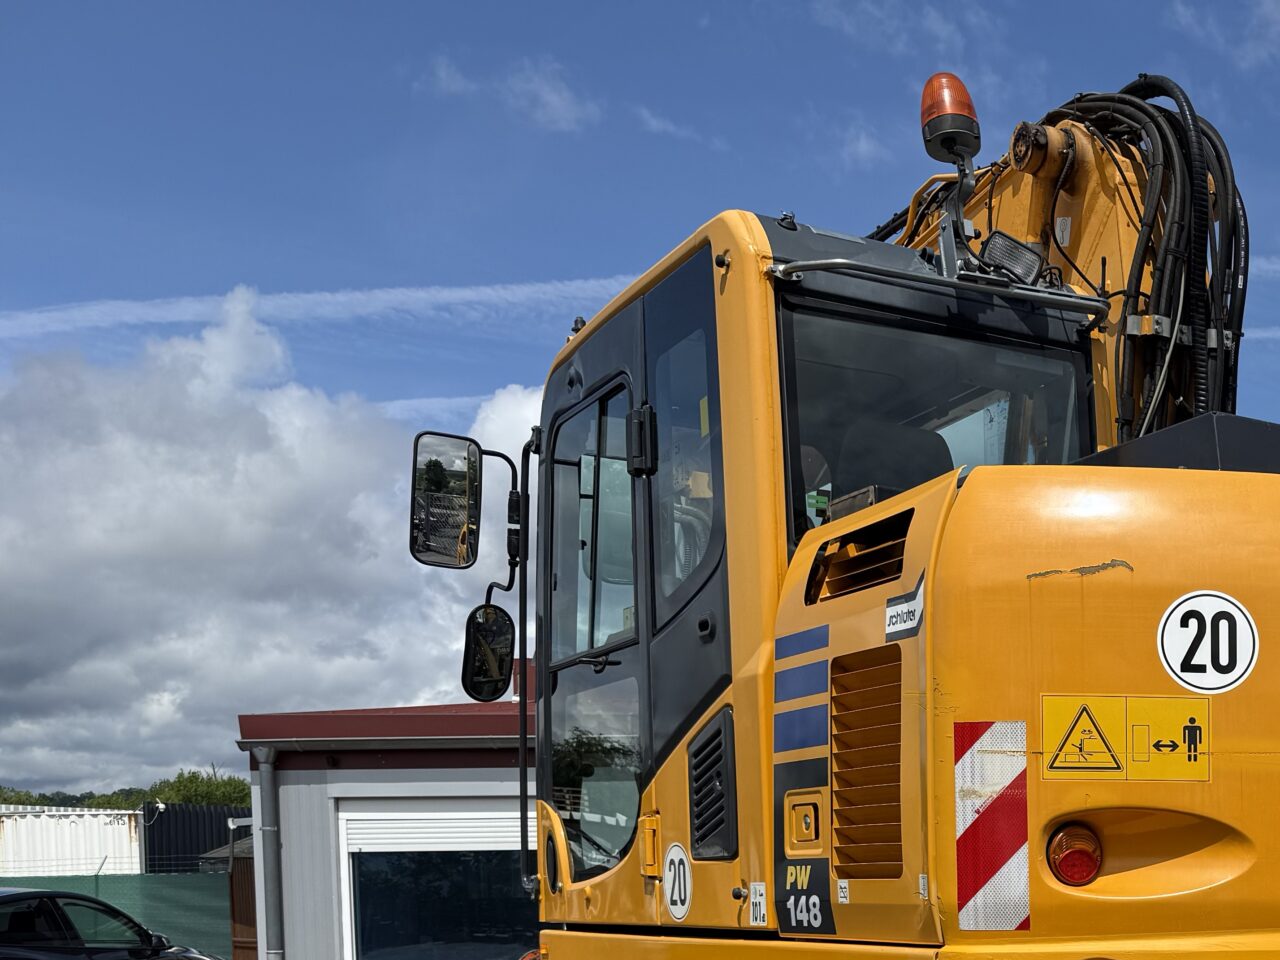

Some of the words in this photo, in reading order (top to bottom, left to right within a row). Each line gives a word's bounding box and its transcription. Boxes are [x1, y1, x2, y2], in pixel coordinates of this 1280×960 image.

[1180, 609, 1237, 675] 20
[669, 858, 687, 907] 20
[786, 865, 811, 890] PW
[787, 895, 822, 928] 148
